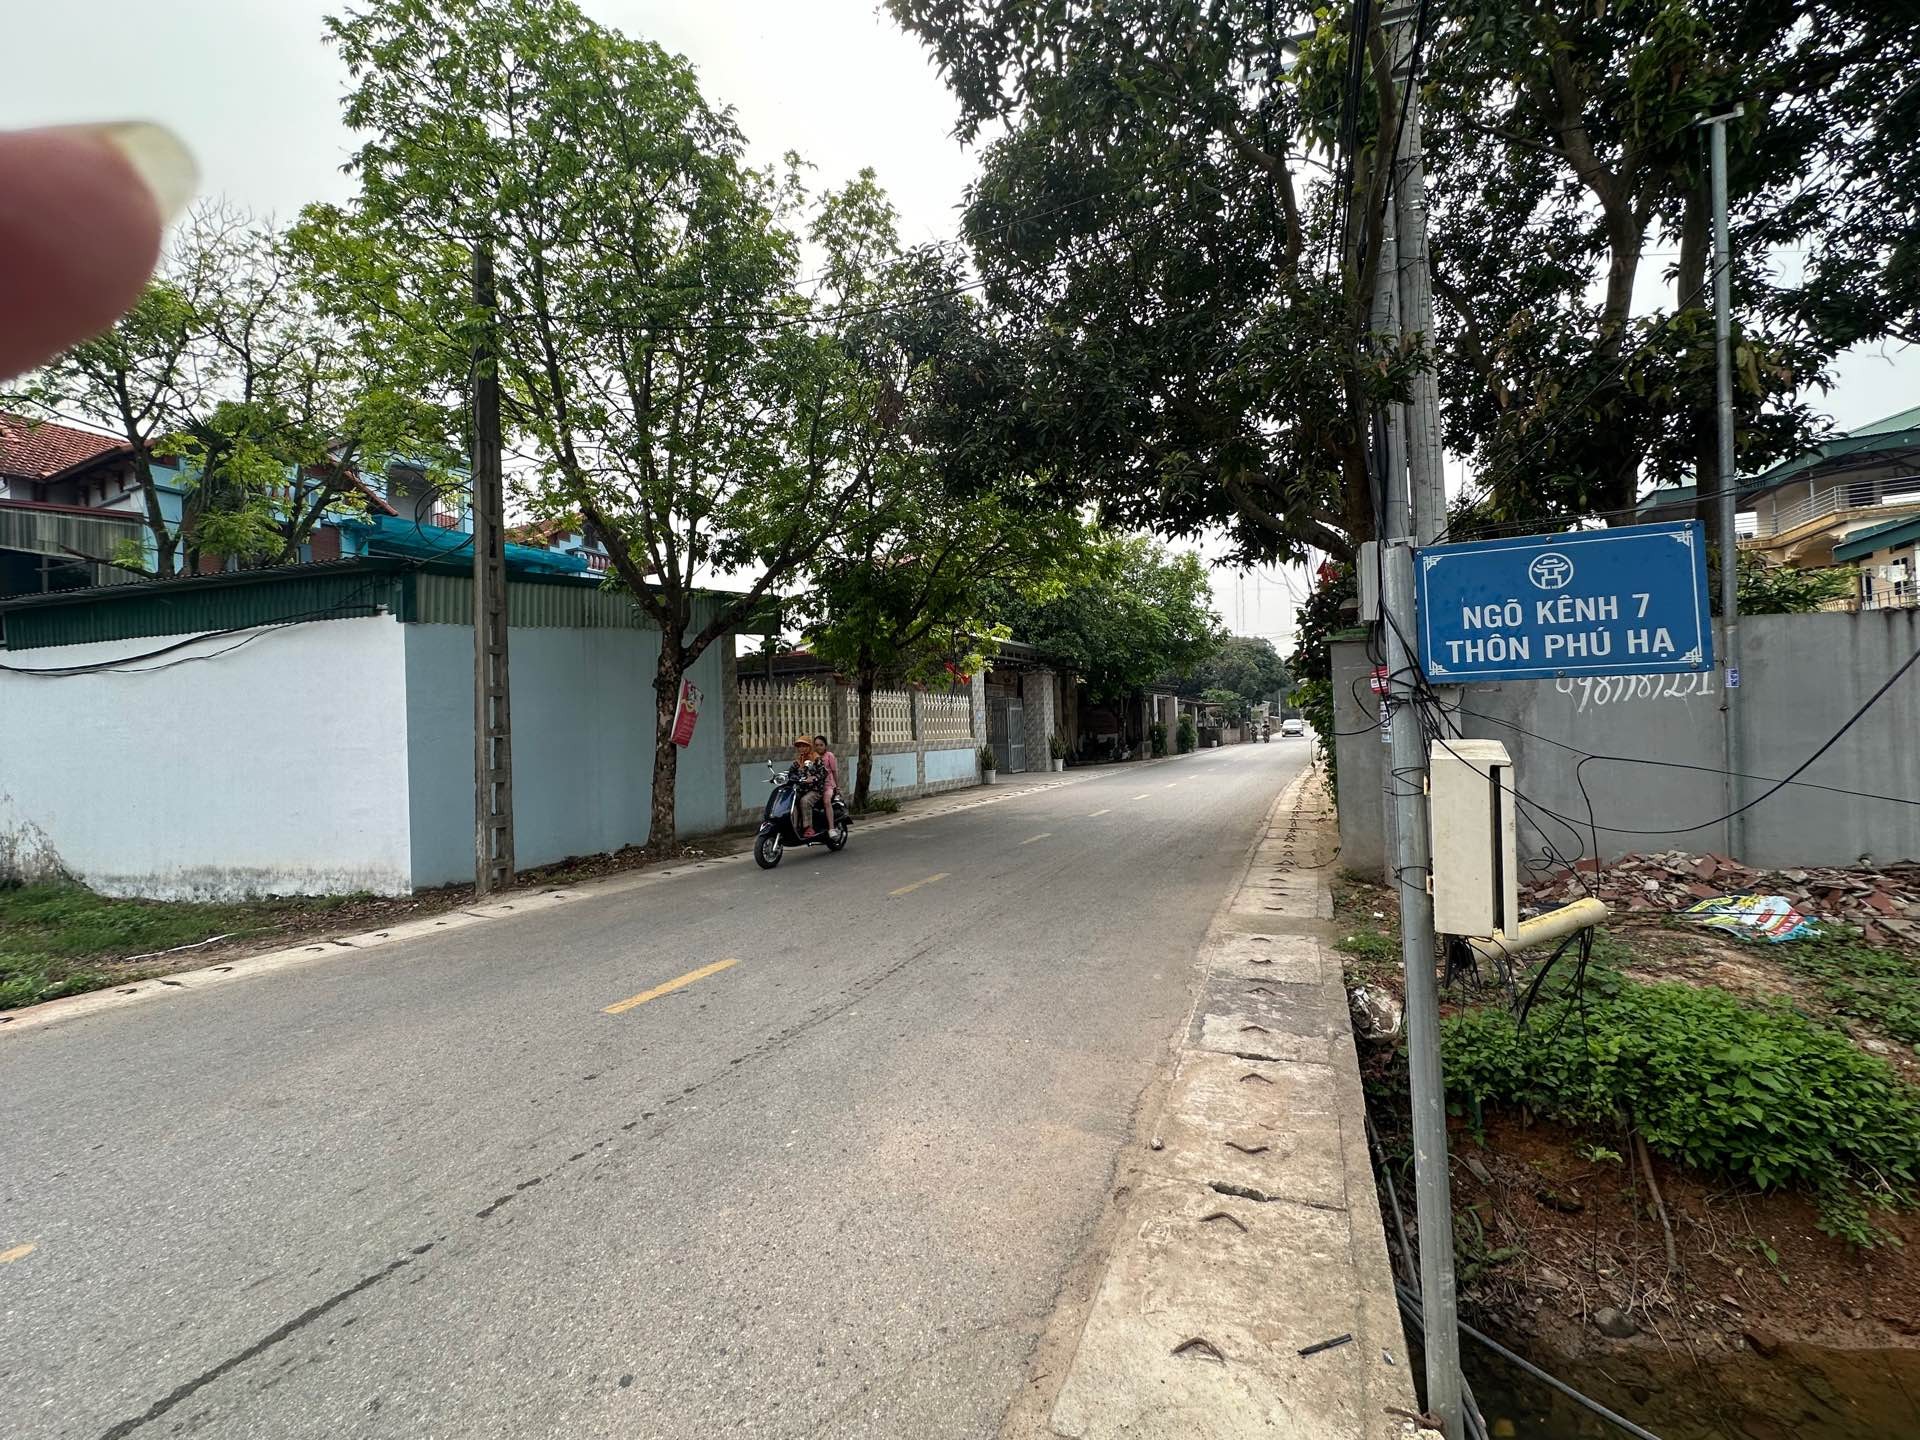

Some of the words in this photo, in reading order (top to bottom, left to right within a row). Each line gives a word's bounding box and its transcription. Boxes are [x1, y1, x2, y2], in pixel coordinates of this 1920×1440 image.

[1462, 598, 1523, 630] NGÕ
[1536, 594, 1618, 625] KÊNH
[1632, 593, 1650, 618] 7
[1445, 633, 1530, 664] THÔN
[1544, 627, 1611, 659] PHÚ
[1627, 627, 1675, 658] HẠ
